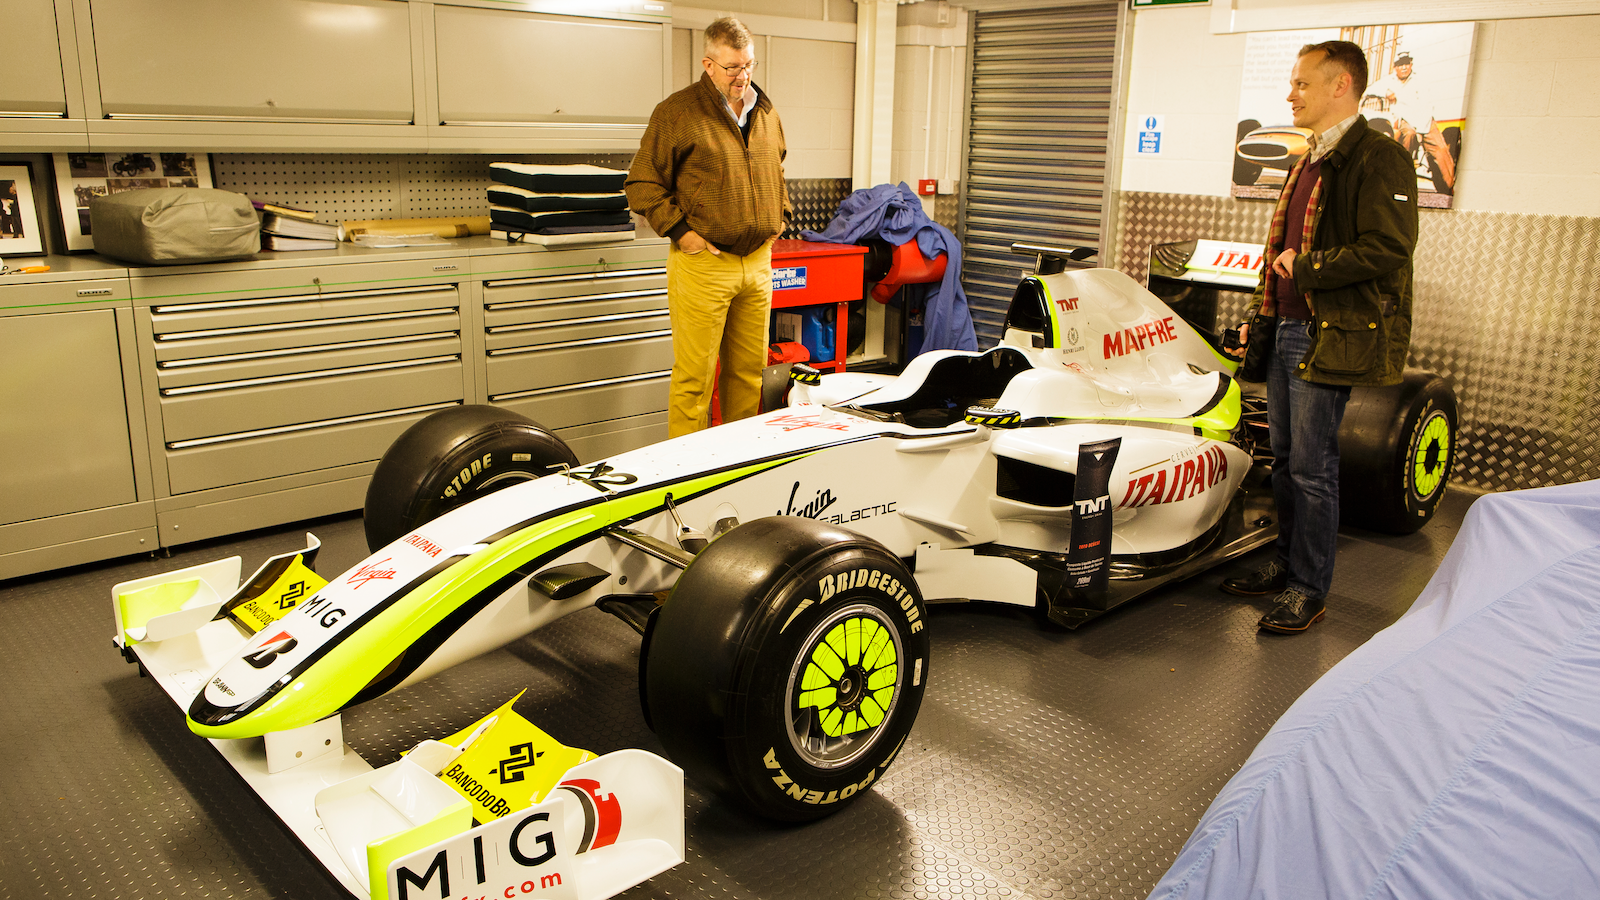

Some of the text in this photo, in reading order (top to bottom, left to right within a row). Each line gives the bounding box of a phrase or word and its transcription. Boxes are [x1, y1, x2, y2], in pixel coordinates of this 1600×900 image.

[781, 276, 806, 287] WASHER
[1056, 297, 1079, 312] TNT
[1103, 316, 1178, 360] MAPFRE
[440, 453, 492, 499] STONE
[1112, 444, 1228, 513] ITAIPAVA
[776, 481, 837, 519] Vgin
[1074, 495, 1110, 515] TNT
[402, 533, 443, 559] ITAIPAVA
[346, 557, 397, 590] Virgin
[298, 594, 347, 629] MIG
[818, 568, 924, 634] BRIDGESTONE
[762, 746, 877, 805] POTENZA
